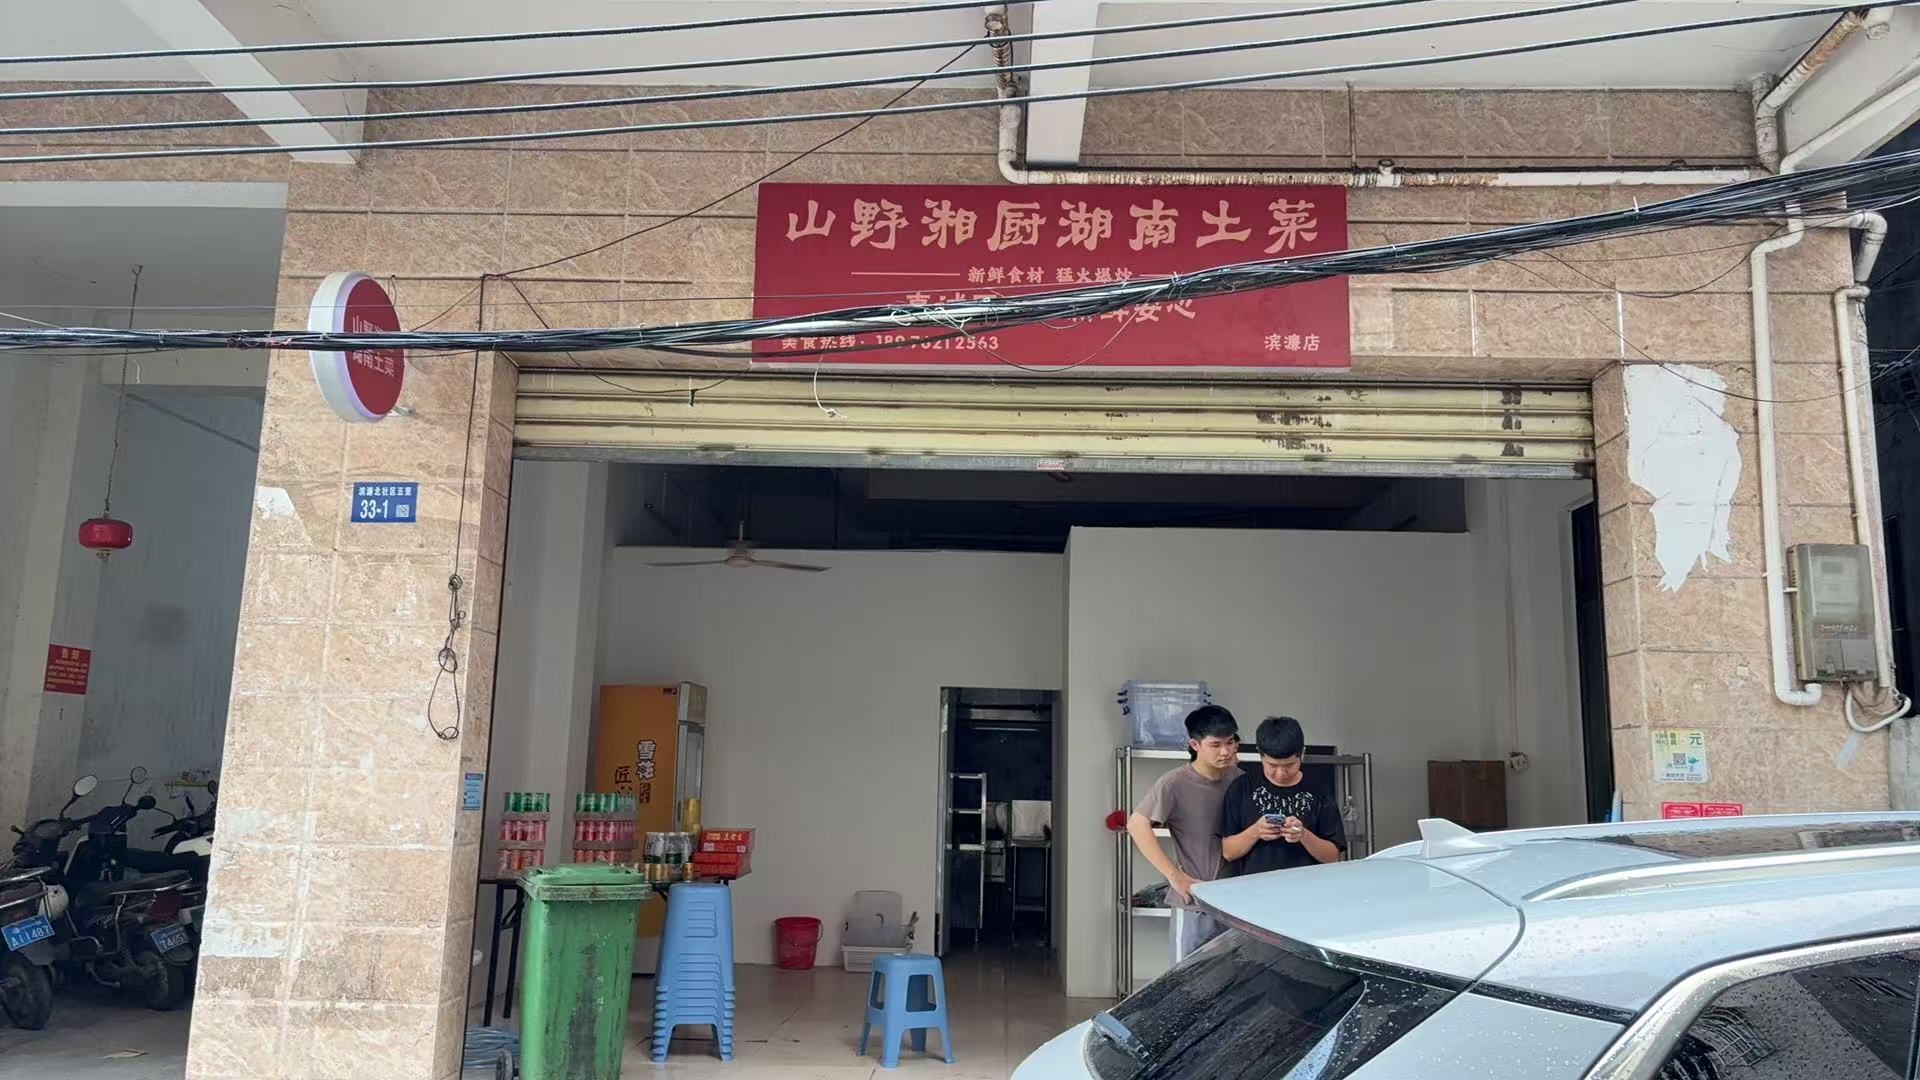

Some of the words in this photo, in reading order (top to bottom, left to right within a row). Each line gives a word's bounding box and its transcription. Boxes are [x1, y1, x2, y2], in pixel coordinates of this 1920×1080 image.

[785, 199, 1320, 254] 山野湘厨湖南土菜
[967, 266, 1044, 284] 新鲜食材
[1056, 266, 1133, 284] 猛火爆炒
[1263, 333, 1321, 352] 滨濂店
[360, 499, 389, 519] 33-1
[636, 739, 657, 780] 雪花
